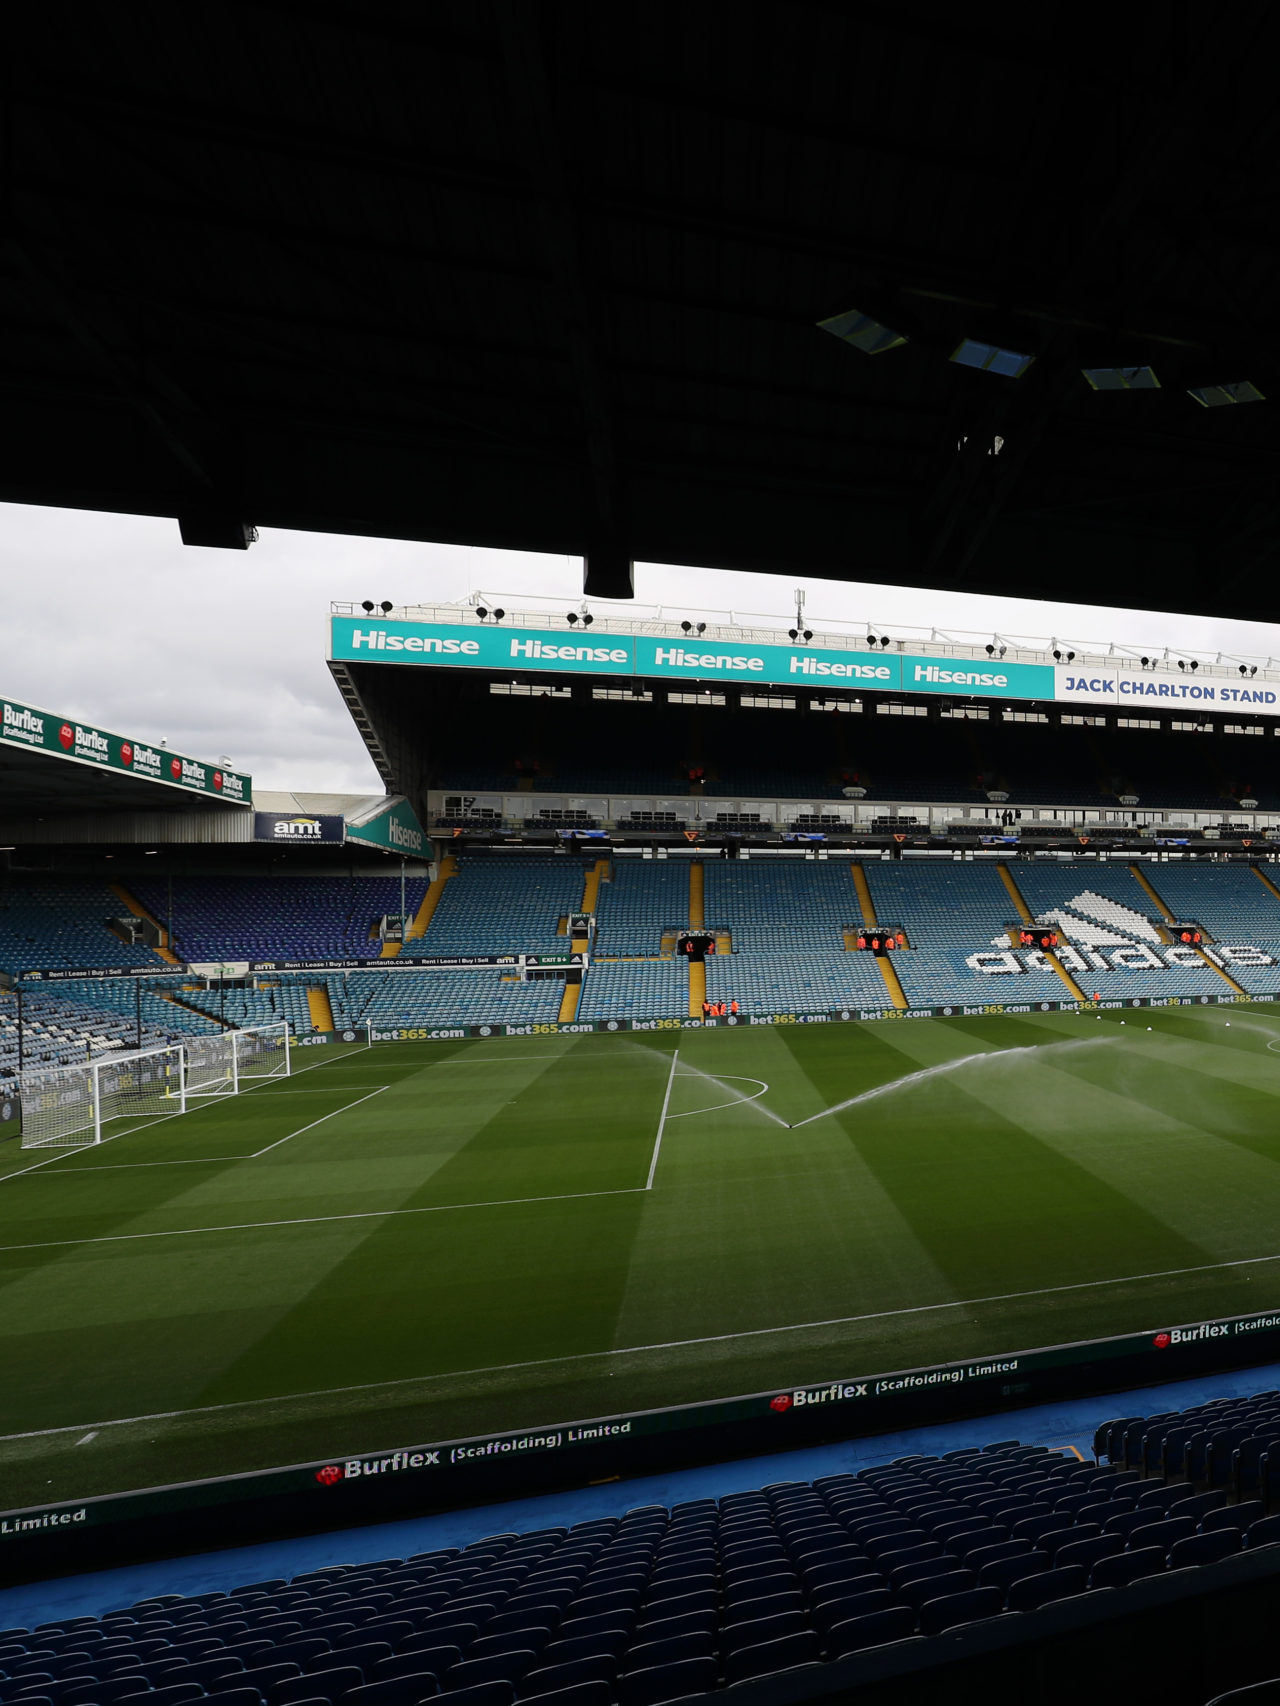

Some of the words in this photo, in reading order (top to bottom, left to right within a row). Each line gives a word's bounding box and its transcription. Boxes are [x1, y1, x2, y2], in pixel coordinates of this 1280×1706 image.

[352, 630, 480, 655] Hisense
[510, 639, 628, 663] Hisense
[655, 648, 764, 671] Hisense
[790, 656, 890, 680] Hisense
[914, 665, 1008, 687] Hisense
[1065, 677, 1115, 693] JACK
[1119, 680, 1215, 700] CHARLTON
[1220, 688, 1276, 704] STAND
[3, 703, 44, 734] Burflex
[34, 734, 44, 744] Ltd
[75, 726, 108, 752] Burflex
[133, 744, 161, 767] Burflex
[182, 759, 205, 780] Burflex
[273, 820, 322, 834] amt
[388, 815, 422, 850] Hisense
[462, 957, 474, 965] Buy
[965, 943, 1279, 976] adidas
[91, 969, 105, 977] Buy
[130, 966, 182, 974] amtauto.co.uk
[963, 1004, 1031, 1015] bet365.com
[1059, 1000, 1123, 1010] bet365.com
[1217, 995, 1274, 1004] bet365.com
[632, 1017, 717, 1031] bet365.com
[750, 1014, 827, 1025] bet365.com
[860, 1008, 932, 1020] bet365.com
[372, 1028, 465, 1041] bet365.com
[506, 1022, 594, 1036] bet365.com
[1170, 1323, 1229, 1344] Burflex
[793, 1383, 868, 1407] Burflex
[875, 1369, 964, 1395] (Scaffolding)
[968, 1360, 1018, 1377] Limited
[344, 1449, 440, 1479] Burflex
[450, 1433, 562, 1463] (Scaffolding)
[568, 1422, 631, 1442] Limited
[1, 1508, 86, 1534] Limited
